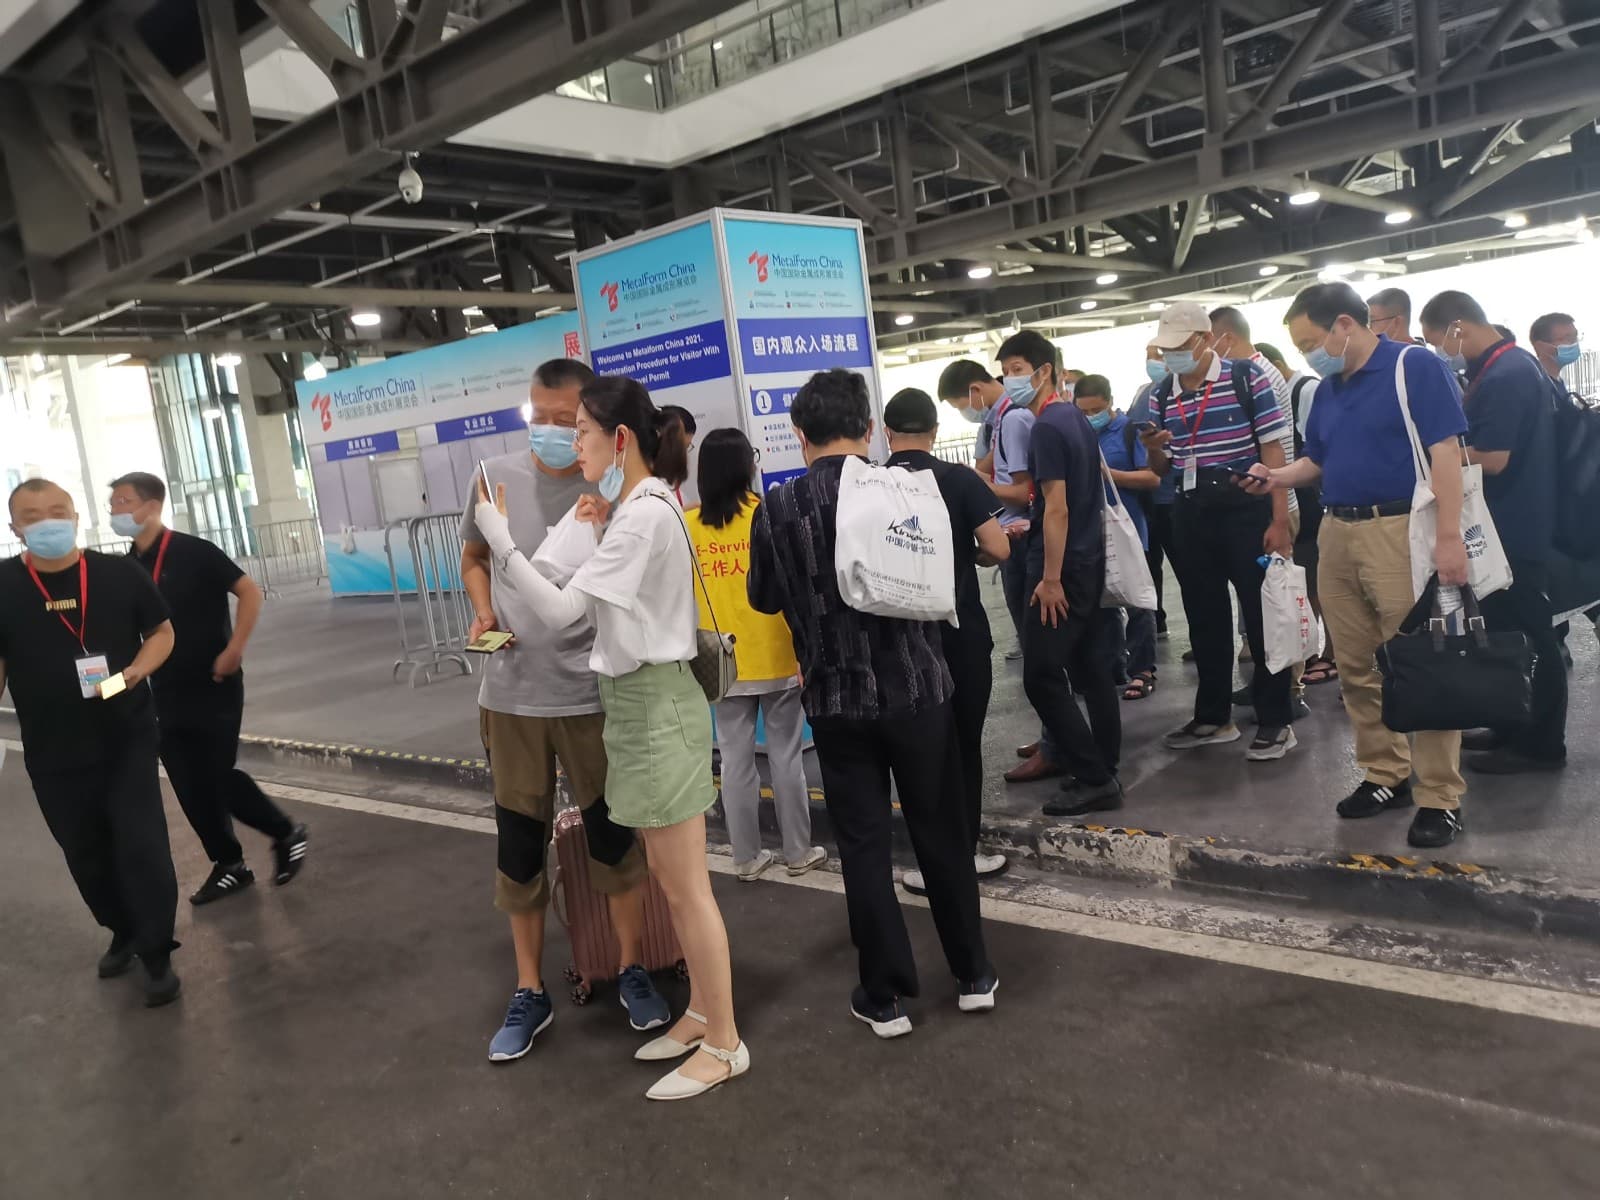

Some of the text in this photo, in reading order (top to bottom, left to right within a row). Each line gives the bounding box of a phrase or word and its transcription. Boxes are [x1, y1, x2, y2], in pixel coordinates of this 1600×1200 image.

[772, 253, 843, 269] MetalForm China
[621, 262, 696, 291] MetalForm China
[564, 331, 582, 361] 展
[597, 353, 625, 365] Welcome
[626, 350, 632, 359] to
[664, 339, 685, 350] China
[685, 334, 704, 346] 2021.
[636, 358, 669, 371] Procedure
[669, 354, 679, 363] for
[680, 349, 702, 361] Visitor
[702, 345, 720, 356] With
[752, 334, 859, 356] 国内观众入场流程
[649, 370, 670, 381] Permit
[333, 377, 416, 408] MetalForm China
[45, 598, 77, 612] PUMA
